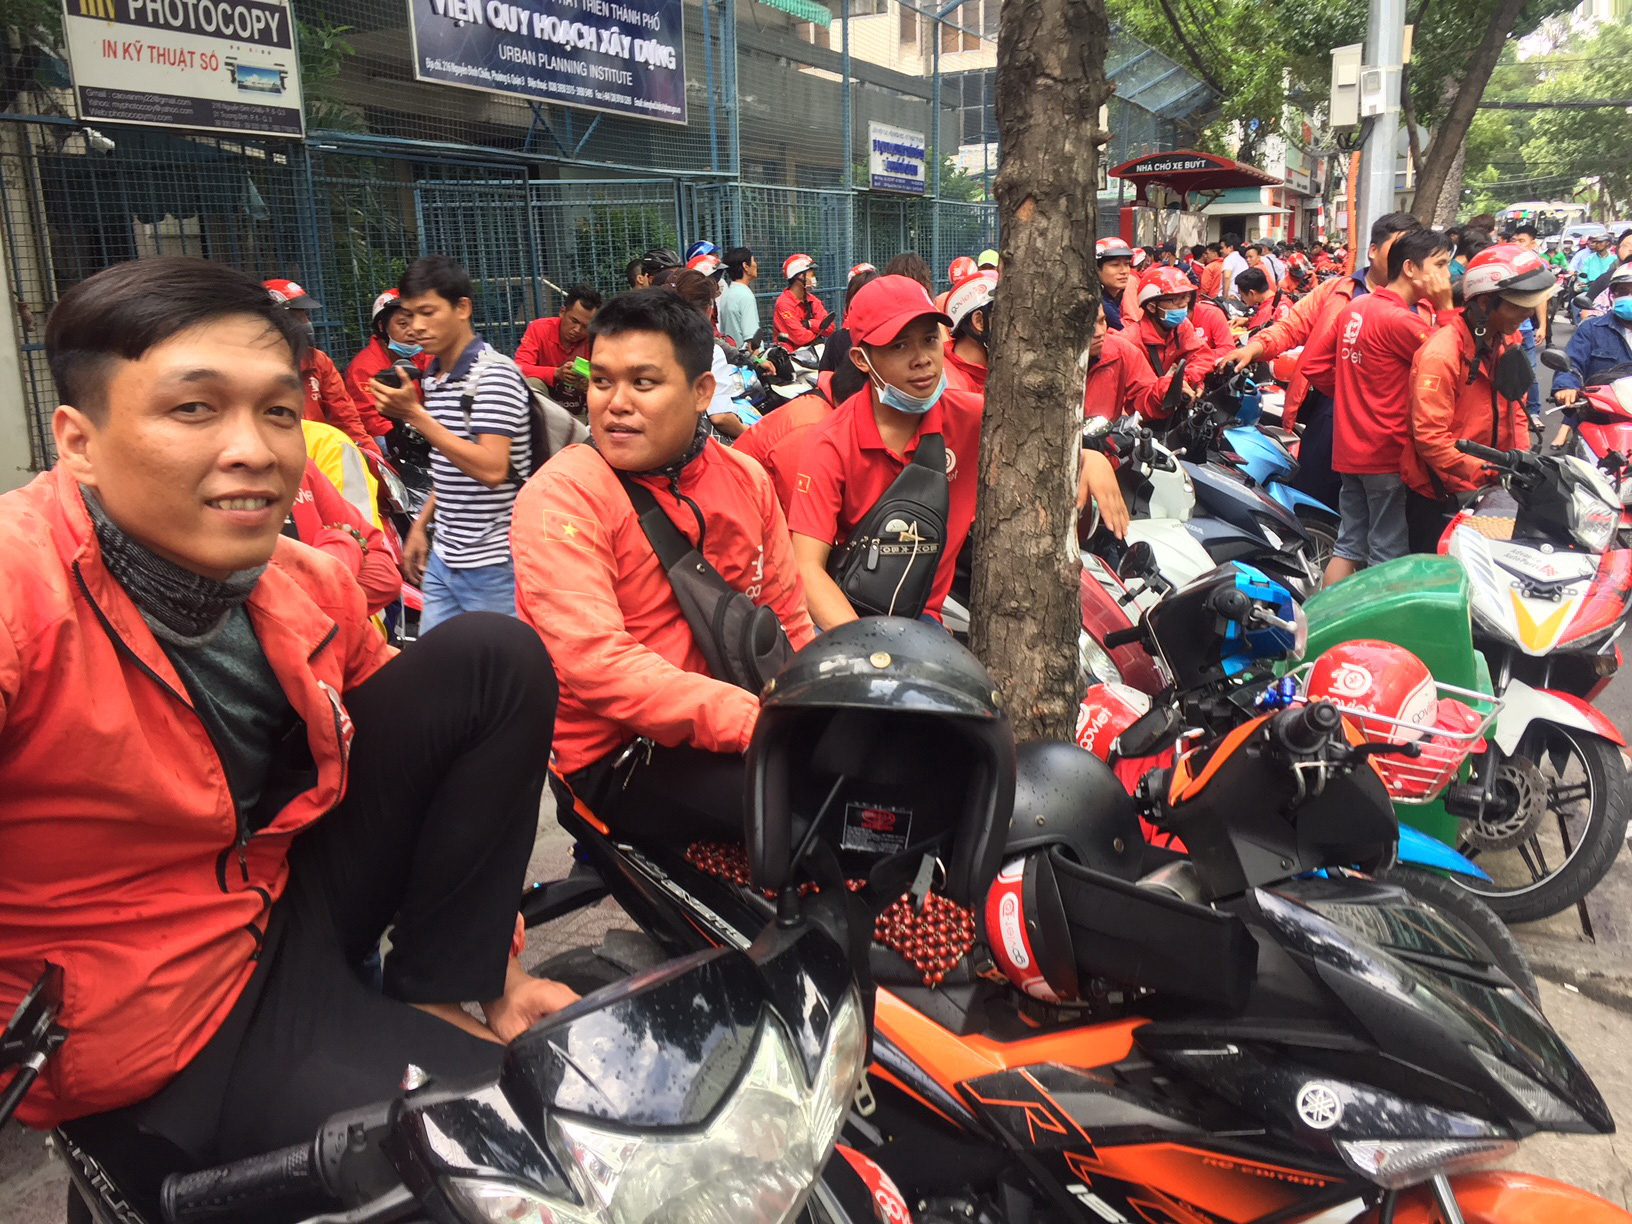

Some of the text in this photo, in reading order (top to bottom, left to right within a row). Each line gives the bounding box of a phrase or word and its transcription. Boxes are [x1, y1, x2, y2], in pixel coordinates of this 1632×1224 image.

[129, 0, 280, 42] PHOTOCOPY
[486, 0, 530, 35] QUY
[532, 12, 597, 51] HOẠCH
[598, 26, 632, 59] XÂY
[633, 38, 677, 71] DỰNG
[610, 4, 641, 26] THÀNH
[642, 11, 661, 31] PHỐ
[102, 39, 117, 59] IN
[122, 39, 143, 62] KỸ
[498, 43, 633, 86] URBAN PLANNING INSTITUTE
[1136, 161, 1153, 173] NHÀ
[1172, 162, 1183, 170] XE
[1184, 158, 1207, 169] BUÝT
[1079, 707, 1113, 752] goviet
